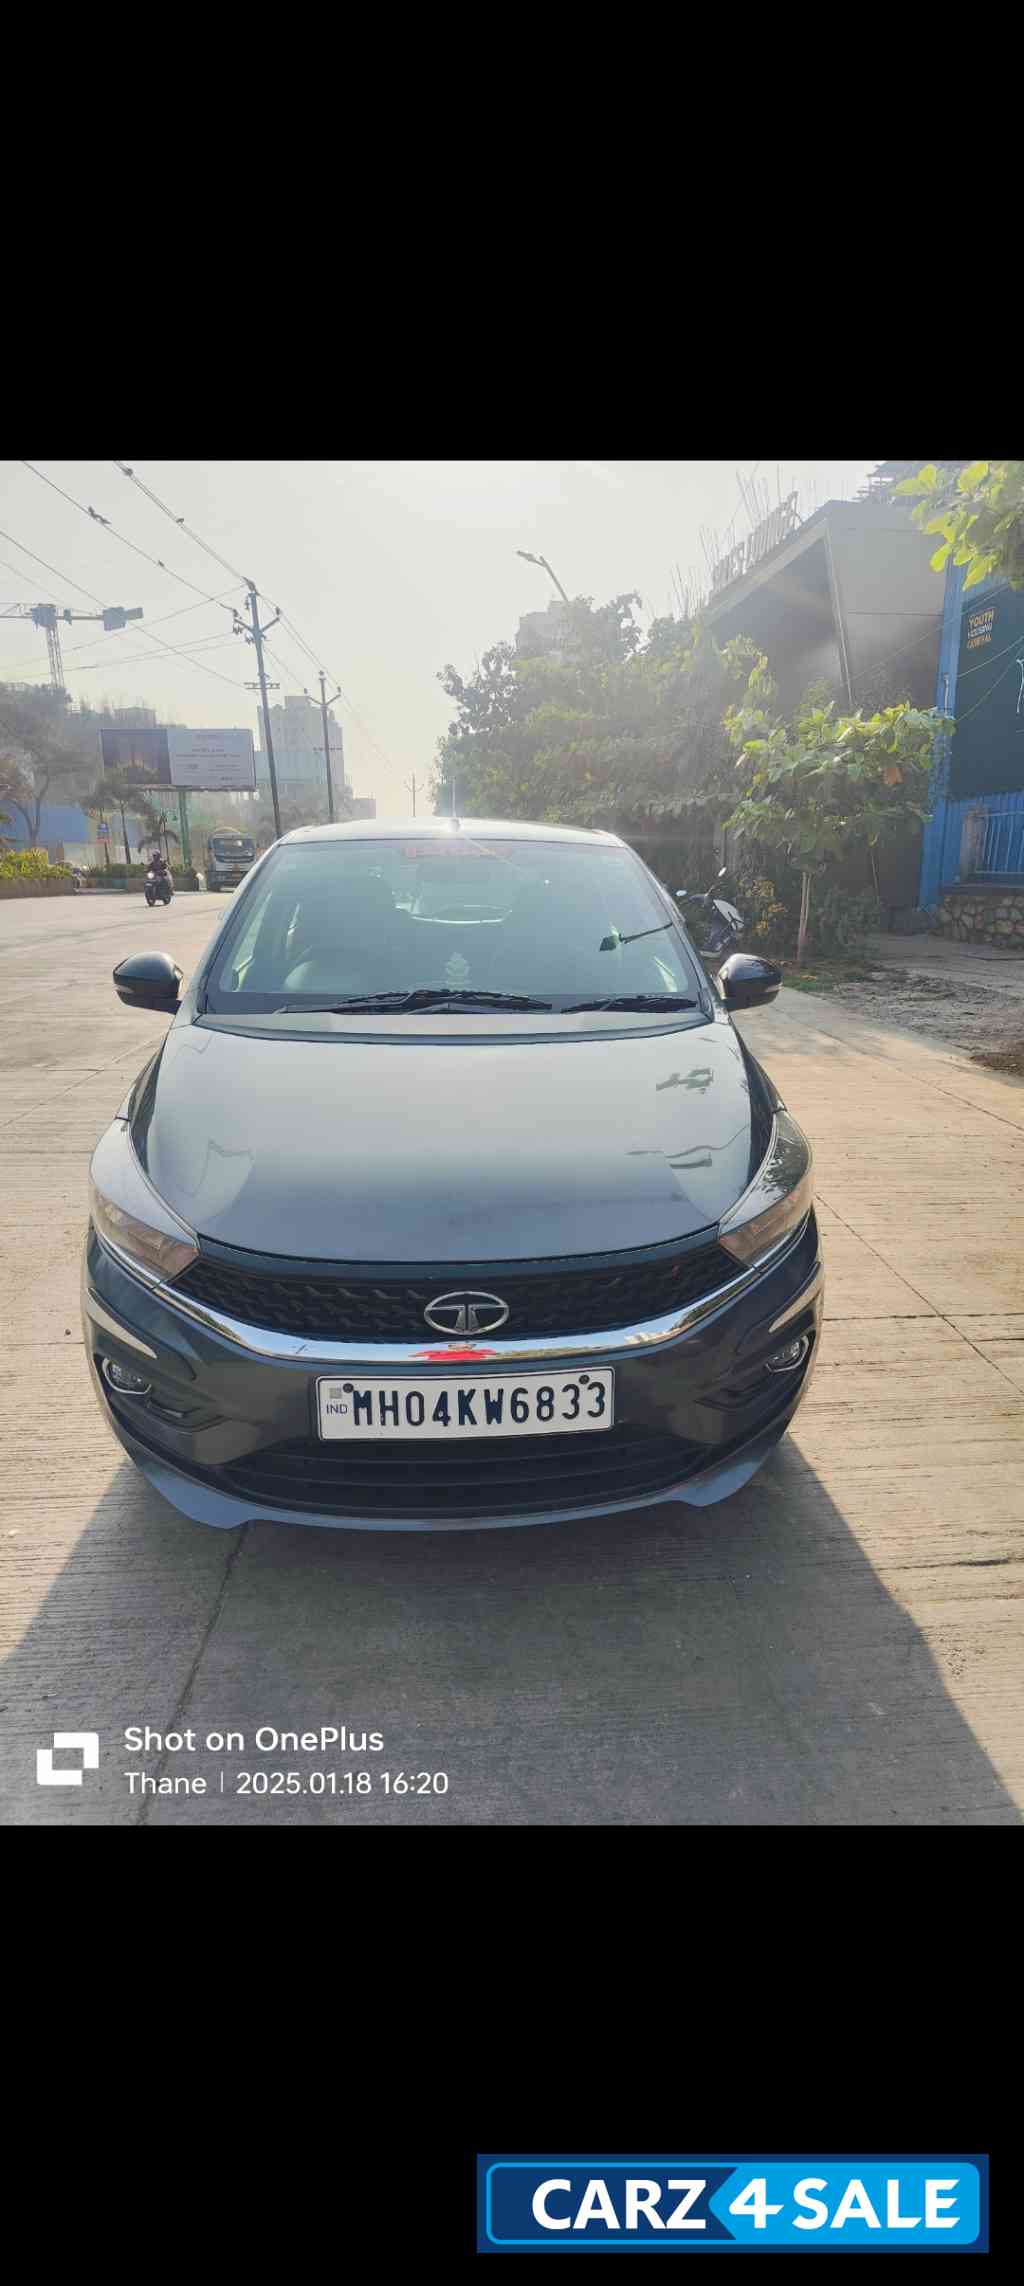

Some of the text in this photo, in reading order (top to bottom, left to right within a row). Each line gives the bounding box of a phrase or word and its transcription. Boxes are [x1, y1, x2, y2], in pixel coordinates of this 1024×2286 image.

[968, 609, 994, 625] YOUTH
[326, 1381, 606, 1426] IND MH04KW6833
